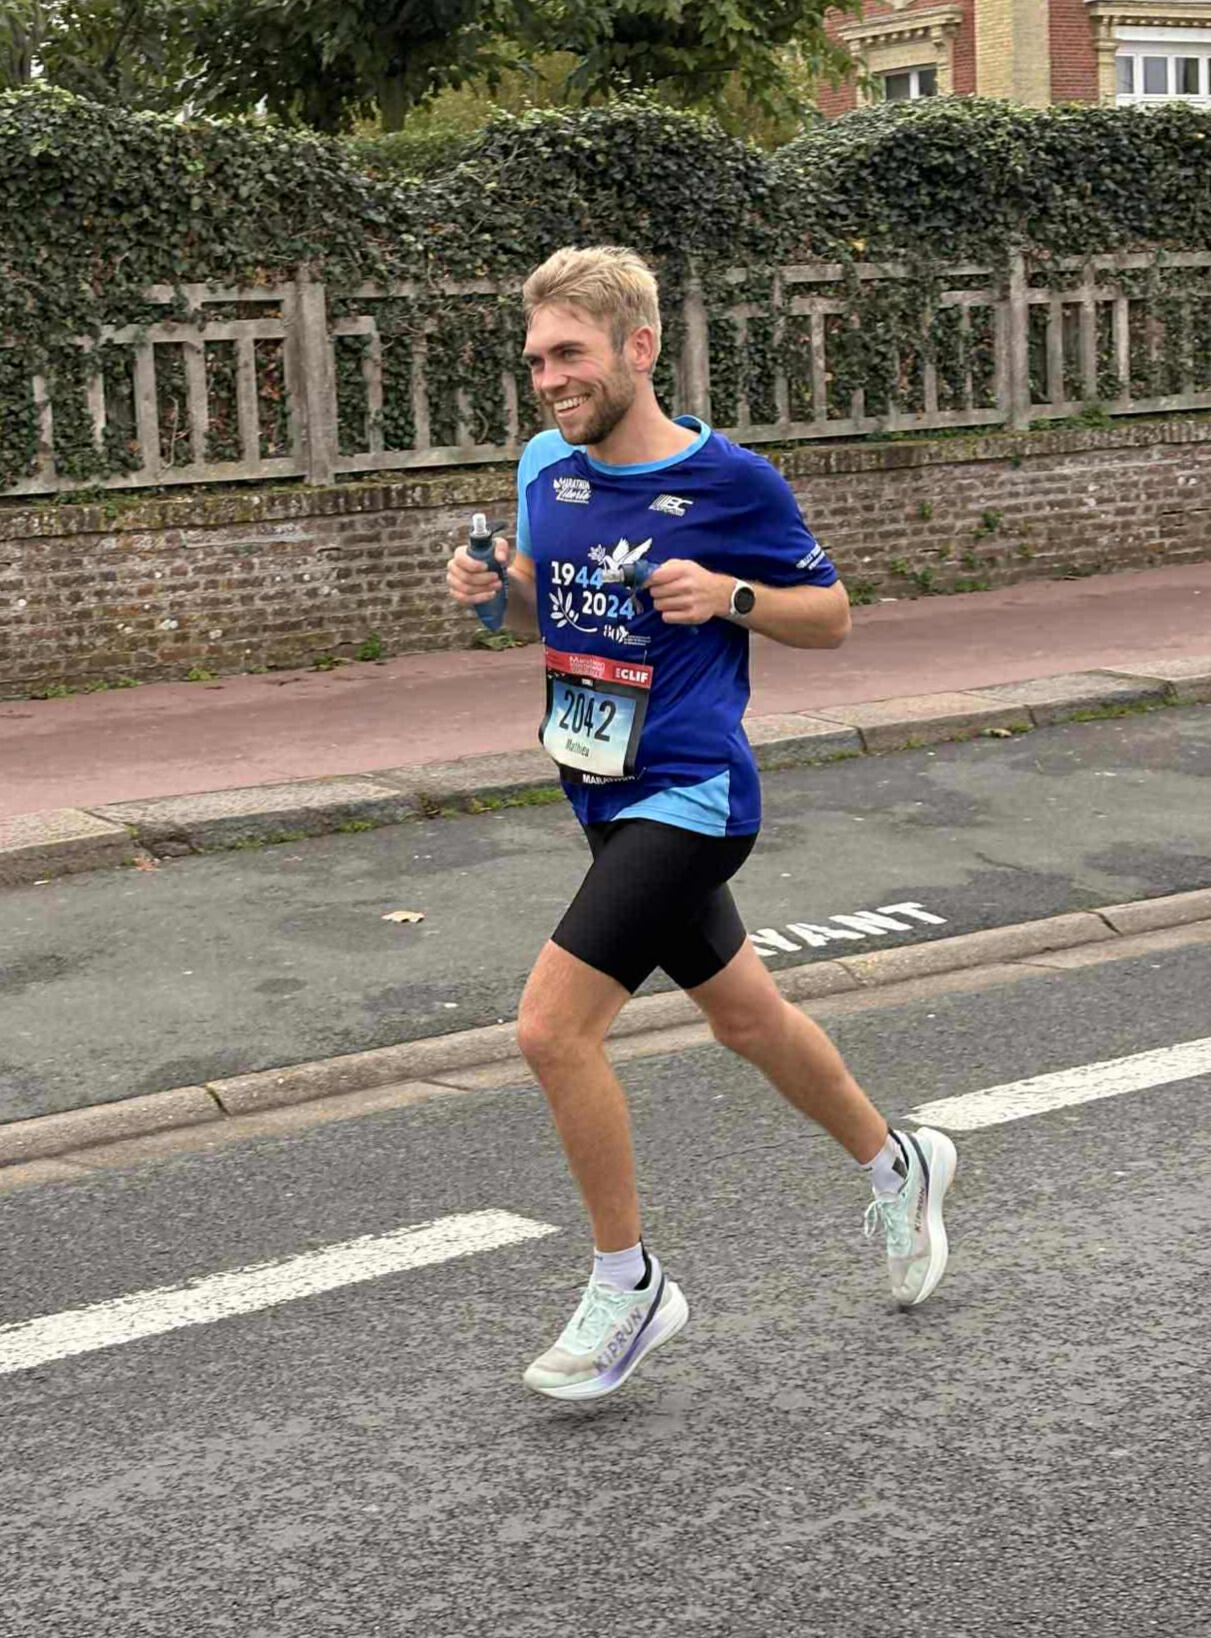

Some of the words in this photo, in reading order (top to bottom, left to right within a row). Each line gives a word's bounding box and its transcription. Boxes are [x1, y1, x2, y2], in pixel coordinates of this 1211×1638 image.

[551, 561, 603, 589] 1944
[582, 591, 635, 620] 2024
[620, 668, 649, 683] CLIF
[559, 689, 616, 742] 2042
[751, 902, 948, 956] VANT
[592, 1306, 644, 1373] KIPRUN
